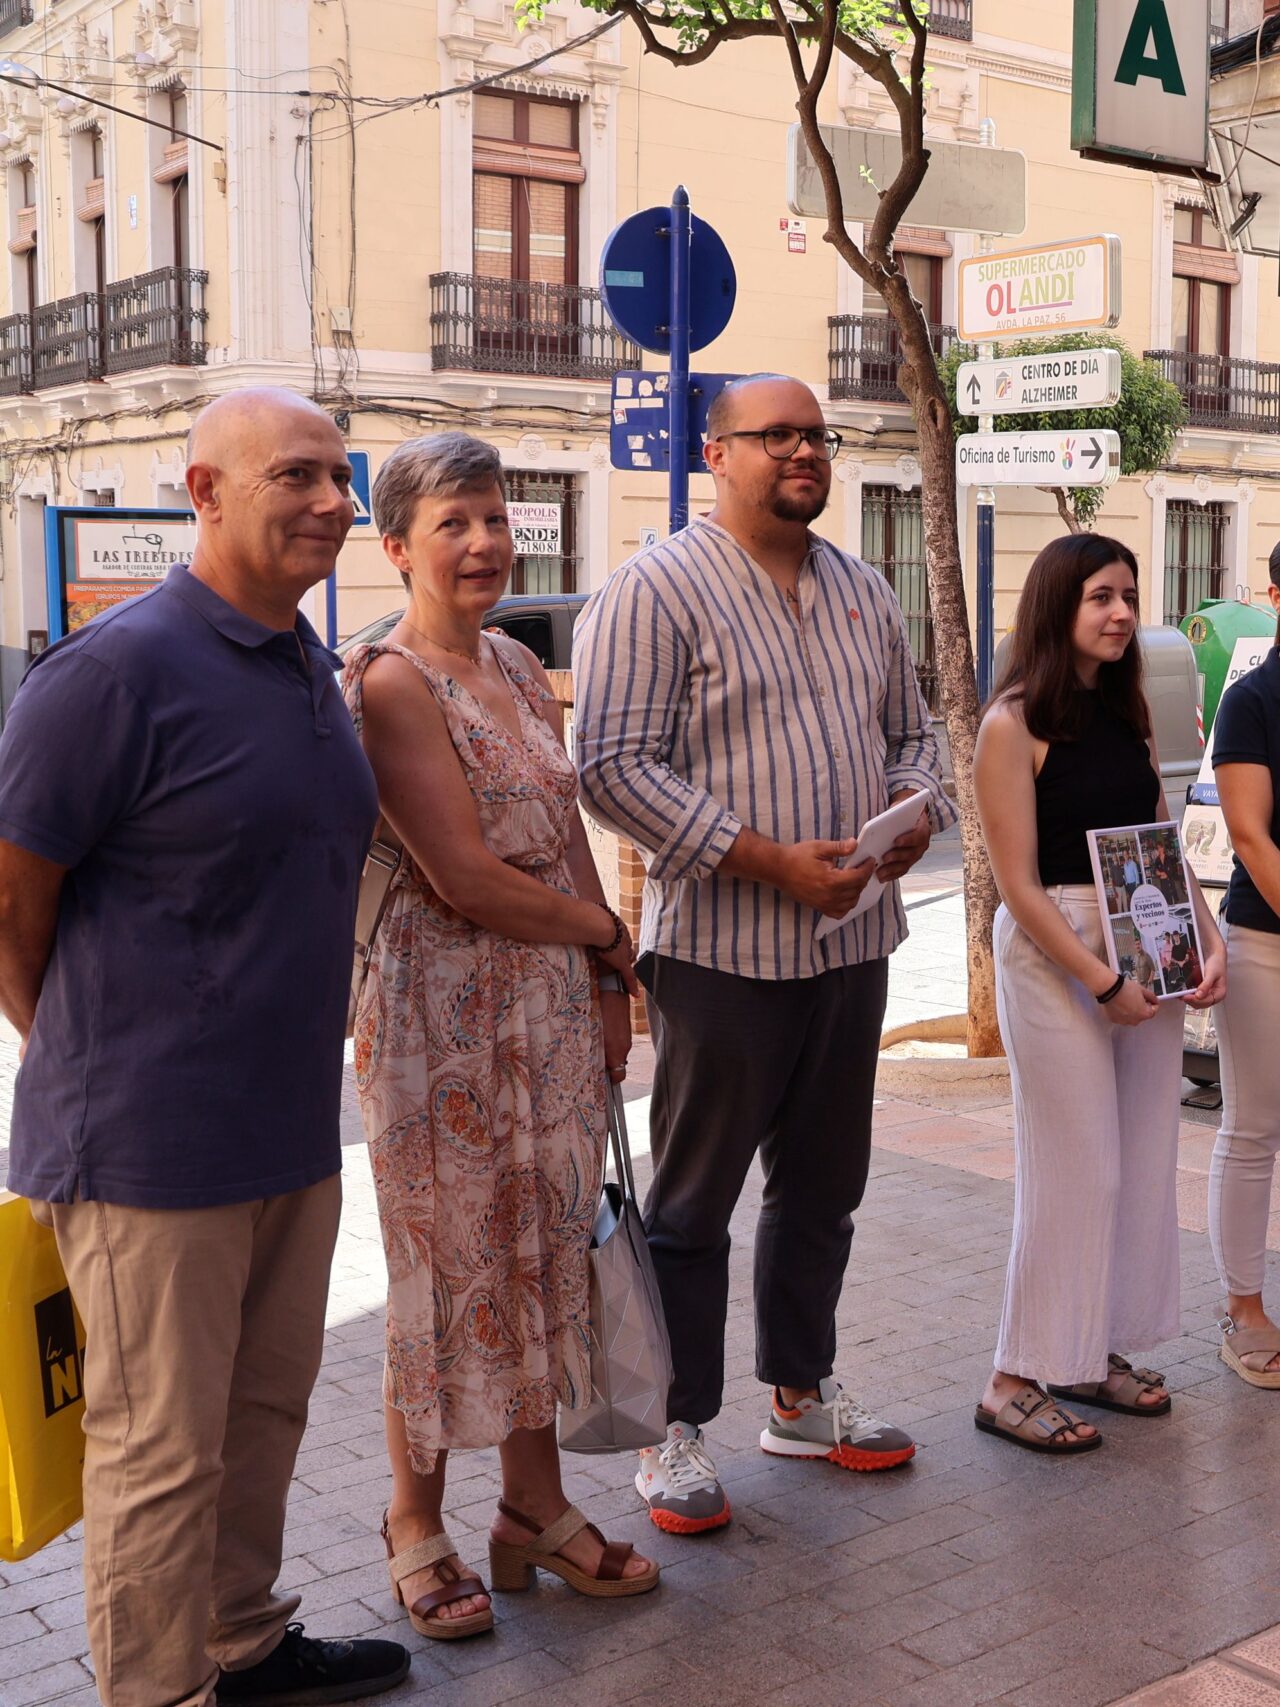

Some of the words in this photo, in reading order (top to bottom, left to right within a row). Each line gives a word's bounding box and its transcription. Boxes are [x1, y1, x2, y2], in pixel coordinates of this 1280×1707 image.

[1113, 0, 1187, 97] A
[978, 248, 1087, 283] SUPERMERCADO
[1022, 318, 1033, 328] LA
[1055, 312, 1067, 322] 56
[1021, 361, 1061, 381] CENTRO
[1064, 360, 1077, 376] DE
[1080, 355, 1099, 374] DÍA
[1021, 384, 1078, 404] ALZHEIMER
[959, 447, 994, 464] Oficina
[997, 447, 1010, 463] de
[1013, 446, 1056, 463] Turismo
[514, 528, 558, 541] ENDE
[93, 550, 119, 563] LAS
[1134, 901, 1162, 911] Expertos
[1141, 910, 1165, 919] vecinos
